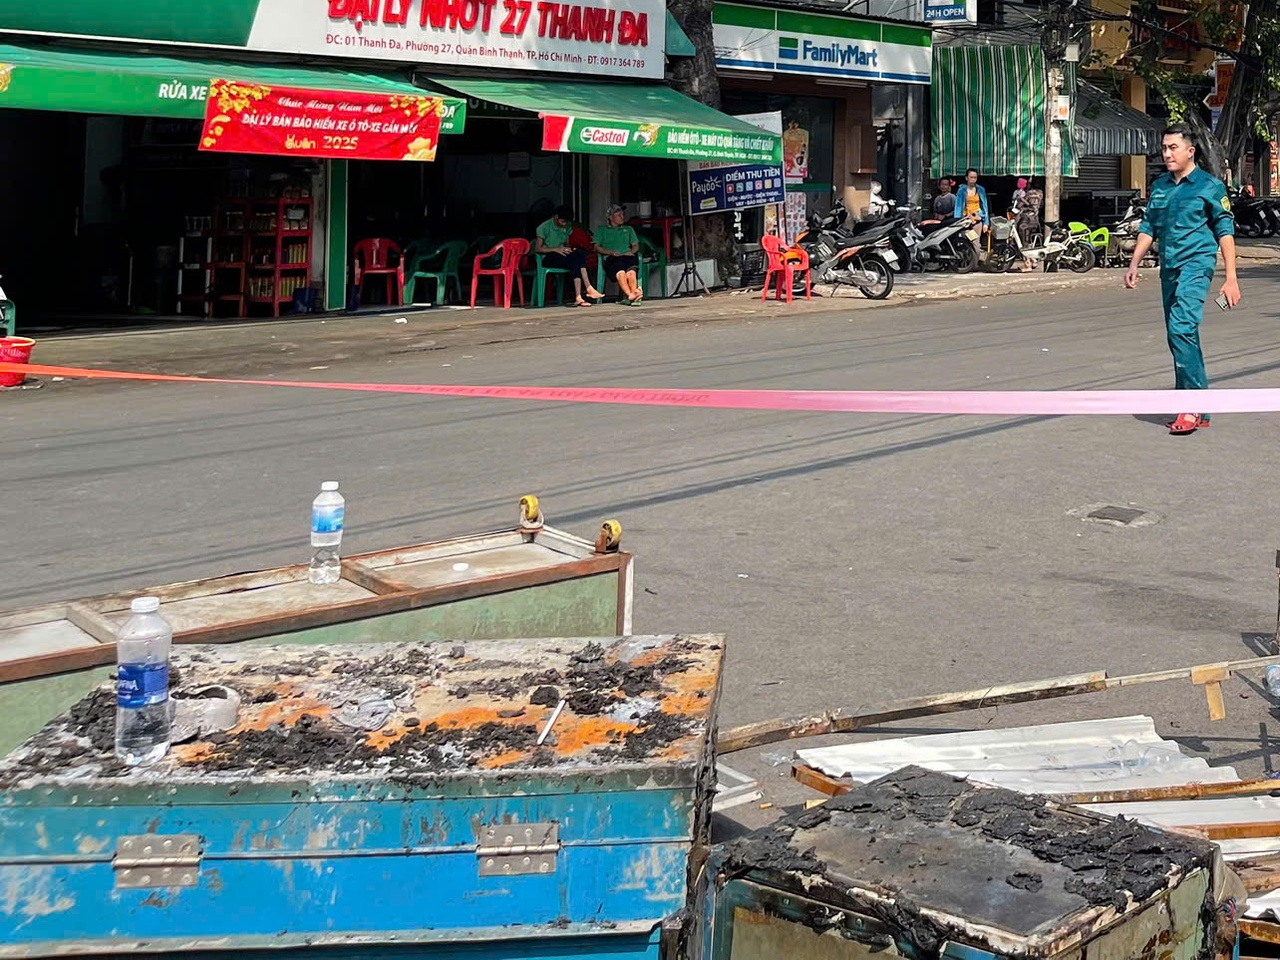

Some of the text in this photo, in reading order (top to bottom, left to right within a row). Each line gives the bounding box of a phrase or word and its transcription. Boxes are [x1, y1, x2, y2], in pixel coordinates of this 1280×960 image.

[943, 7, 965, 17] OPEN
[537, 1, 616, 44] THANH
[618, 10, 649, 47] ĐA
[345, 35, 356, 46] 01
[358, 37, 387, 49] Thanh
[405, 40, 439, 55] Phường
[441, 43, 454, 56] 27,
[564, 52, 582, 64] Minh
[600, 56, 617, 67] 0917
[618, 57, 631, 68] 364
[632, 58, 646, 69] 789
[803, 40, 878, 68] FamilyMart
[159, 80, 187, 100] RỬA
[190, 86, 207, 101] XE
[292, 114, 312, 128] BẢO
[336, 120, 349, 131] XE
[322, 135, 359, 150] 2025
[592, 128, 626, 144] Castrol
[746, 169, 763, 179] THU
[692, 180, 716, 195] Payoo
